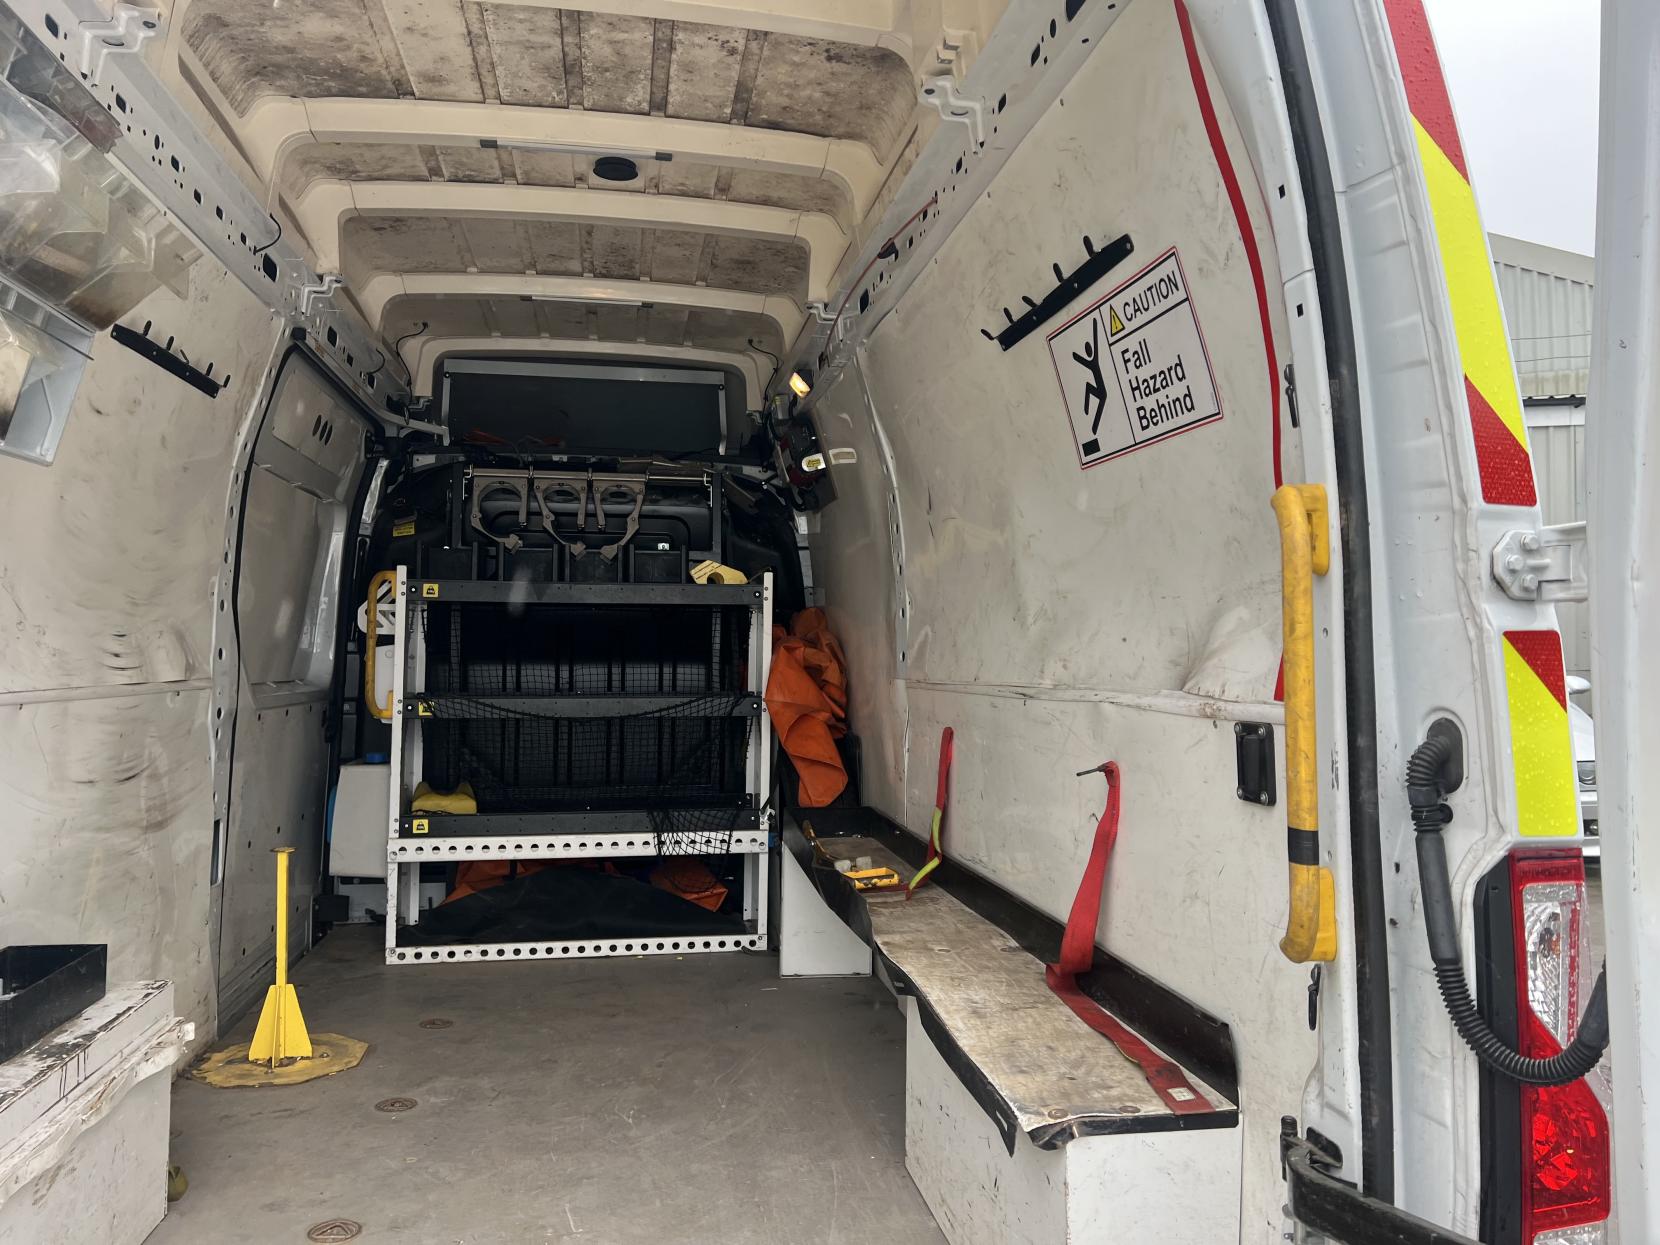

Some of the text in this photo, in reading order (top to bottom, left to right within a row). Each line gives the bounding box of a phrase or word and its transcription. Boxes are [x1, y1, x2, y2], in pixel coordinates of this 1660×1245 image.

[1123, 270, 1179, 322] CAUTION
[1121, 338, 1151, 374] Fall
[1129, 354, 1186, 402] Hazard
[1136, 385, 1195, 431] Behind
